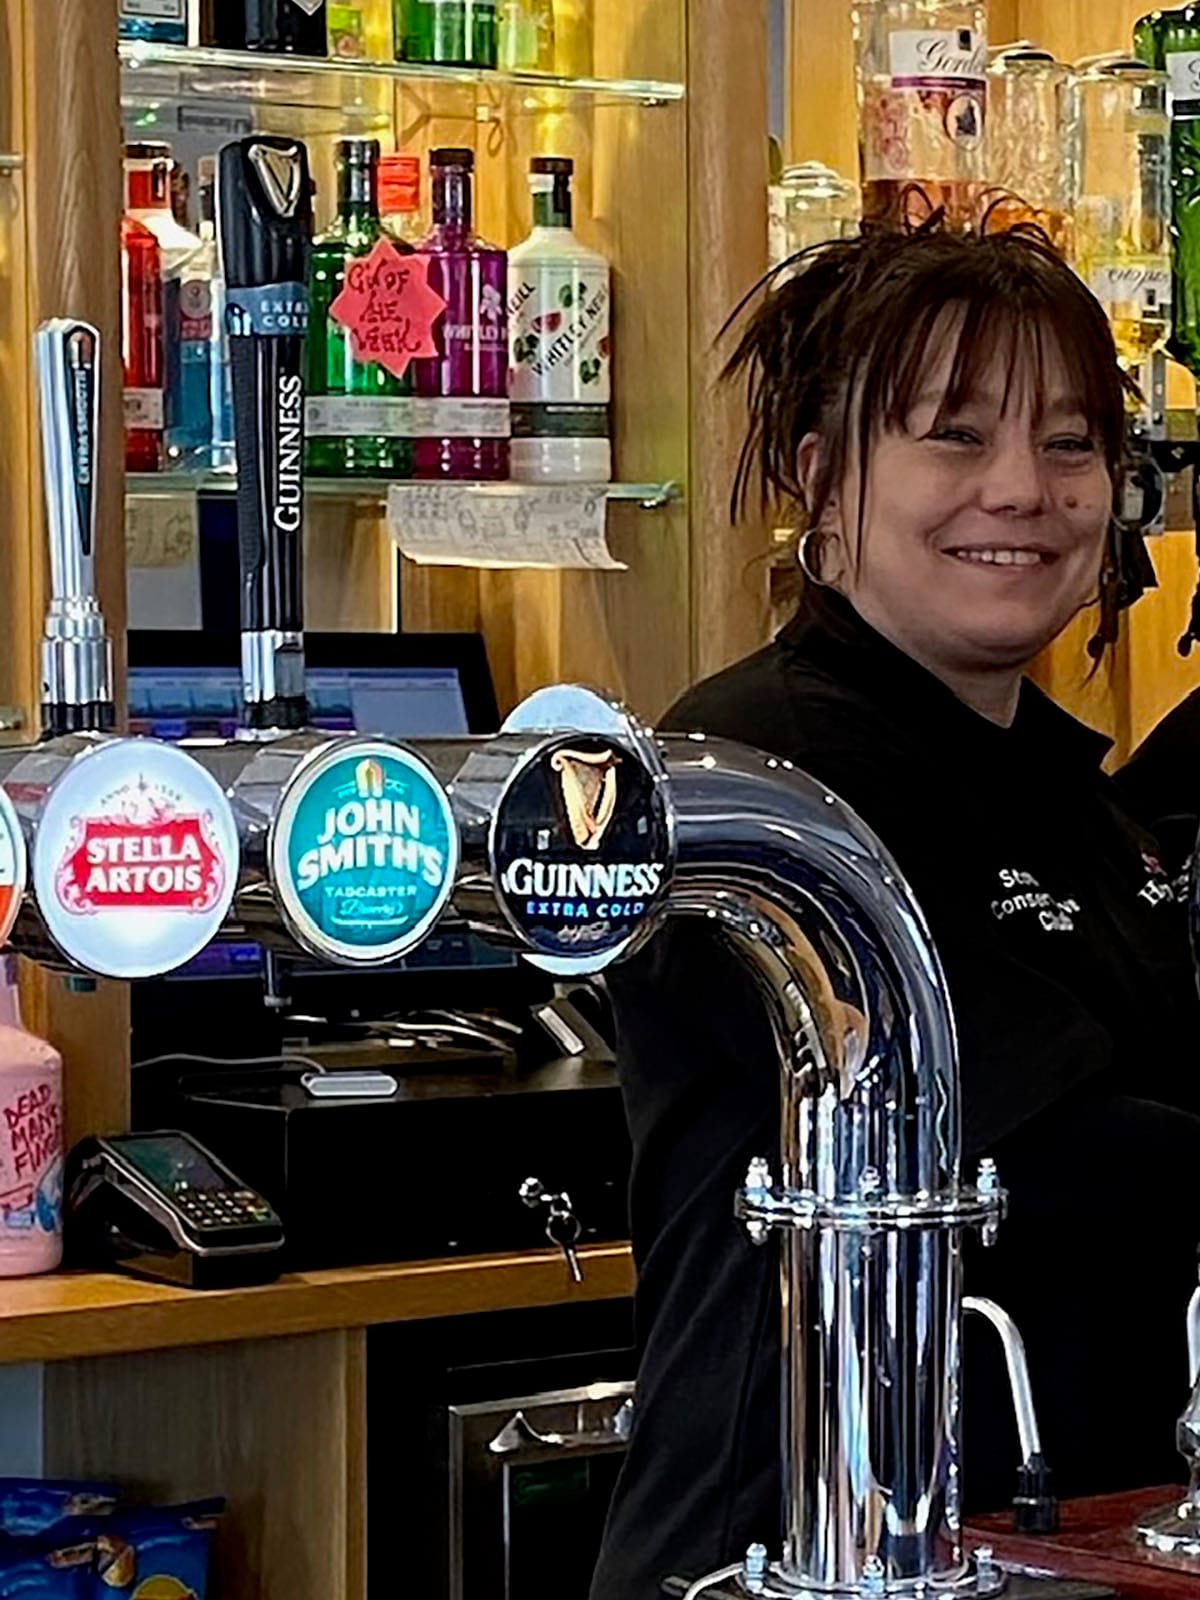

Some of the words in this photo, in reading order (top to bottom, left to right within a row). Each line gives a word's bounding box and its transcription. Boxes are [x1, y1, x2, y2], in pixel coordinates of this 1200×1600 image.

[273, 375, 302, 532] GUINNESS
[317, 798, 421, 844] JOHN
[86, 834, 201, 864] STELLA
[297, 833, 444, 891] SMITH'S
[85, 864, 202, 894] ARTOIS
[325, 885, 418, 898] TADCASTER
[506, 857, 665, 899] GUINNESS
[526, 901, 589, 918] EXTRA
[596, 902, 645, 918] COLD
[3, 1083, 51, 1130] DEAD
